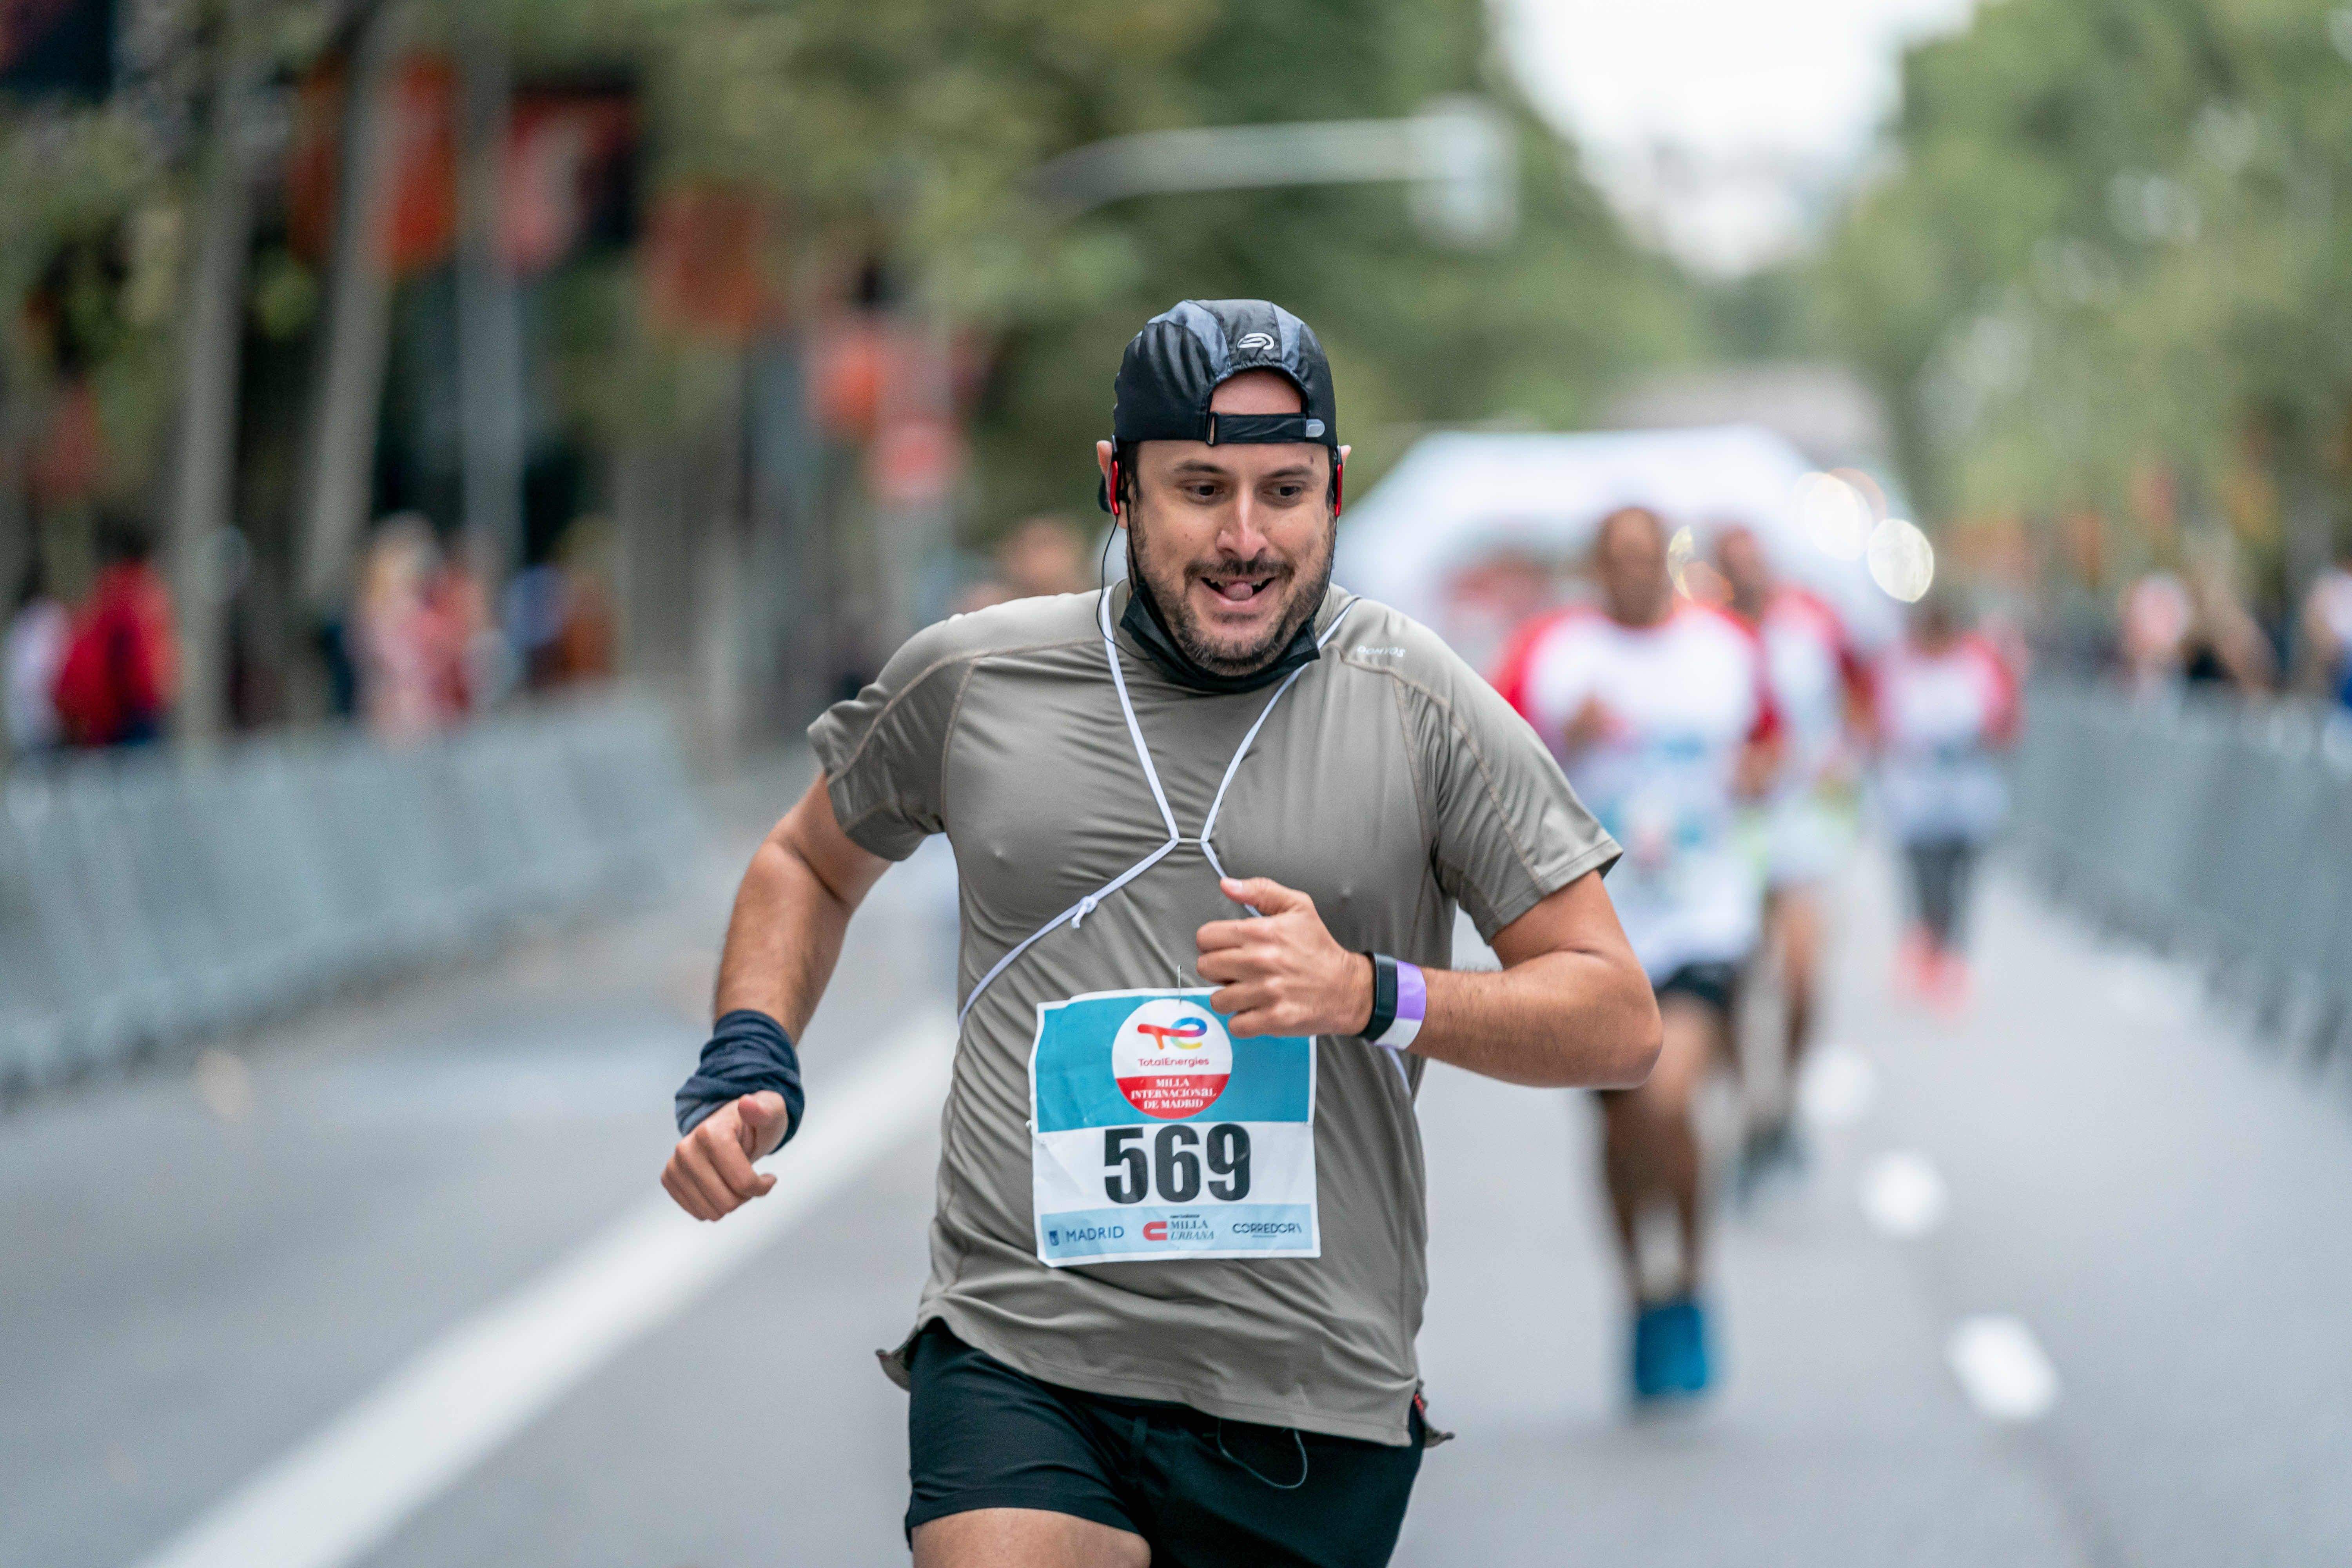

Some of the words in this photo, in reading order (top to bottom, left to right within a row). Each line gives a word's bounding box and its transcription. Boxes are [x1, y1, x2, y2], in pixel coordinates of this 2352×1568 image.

[1138, 1057, 1209, 1067] TotalEnergies
[1156, 1078, 1189, 1087] MILLA
[1131, 1088, 1217, 1099] INTERNACIONAL
[1143, 1100, 1159, 1109] DE
[1161, 1098, 1203, 1109] MADRID
[1104, 1123, 1251, 1204] 569
[1170, 1220, 1209, 1230] MILLA
[1065, 1226, 1125, 1242] MADRID
[1170, 1230, 1215, 1240] URBANA
